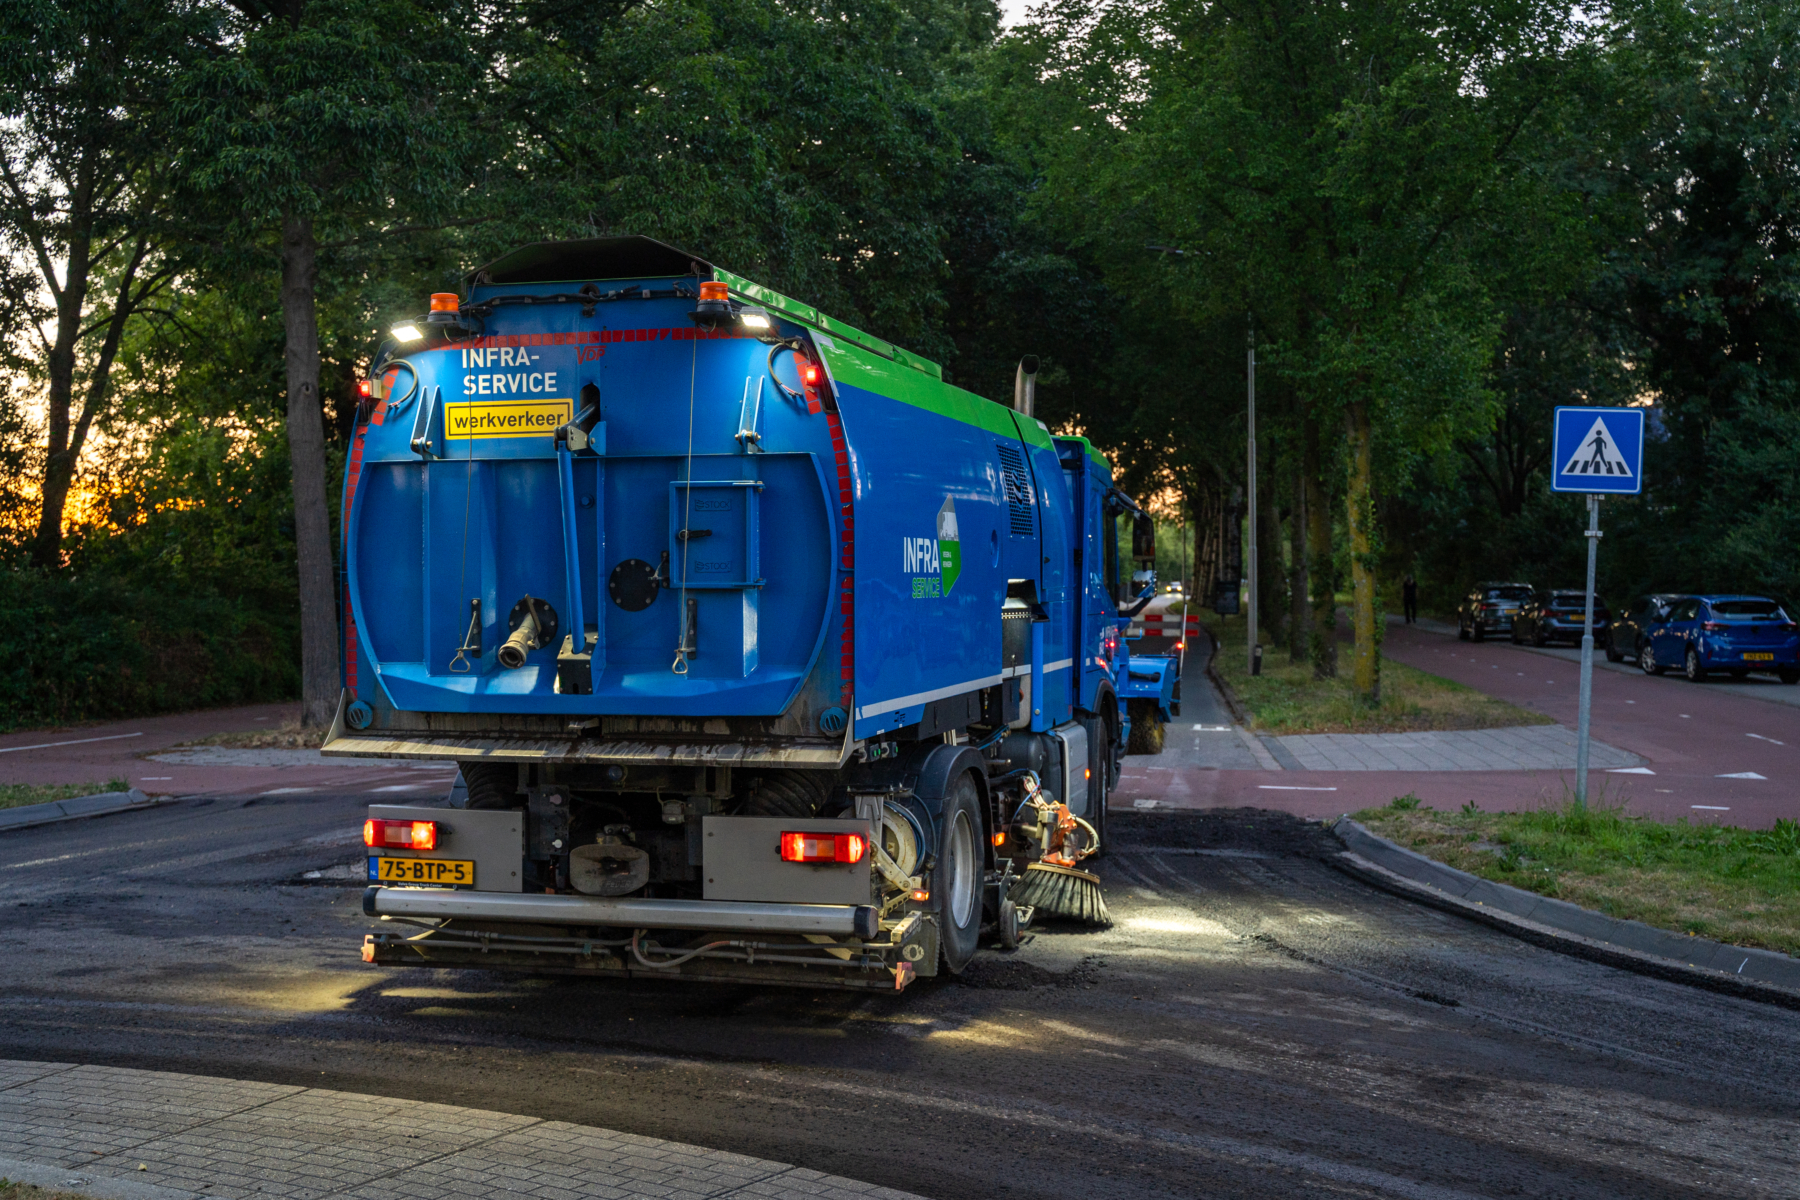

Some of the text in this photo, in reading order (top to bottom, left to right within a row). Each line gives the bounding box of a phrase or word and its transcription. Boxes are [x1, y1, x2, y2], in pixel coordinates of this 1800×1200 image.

[461, 346, 540, 369] INFRA-
[574, 345, 607, 365] VDP
[462, 372, 558, 395] SERVICE
[454, 410, 564, 429] werkverkeer
[903, 536, 940, 573] INFRA
[912, 577, 940, 599] SERVICE
[383, 860, 465, 881] 75-BTP-5
